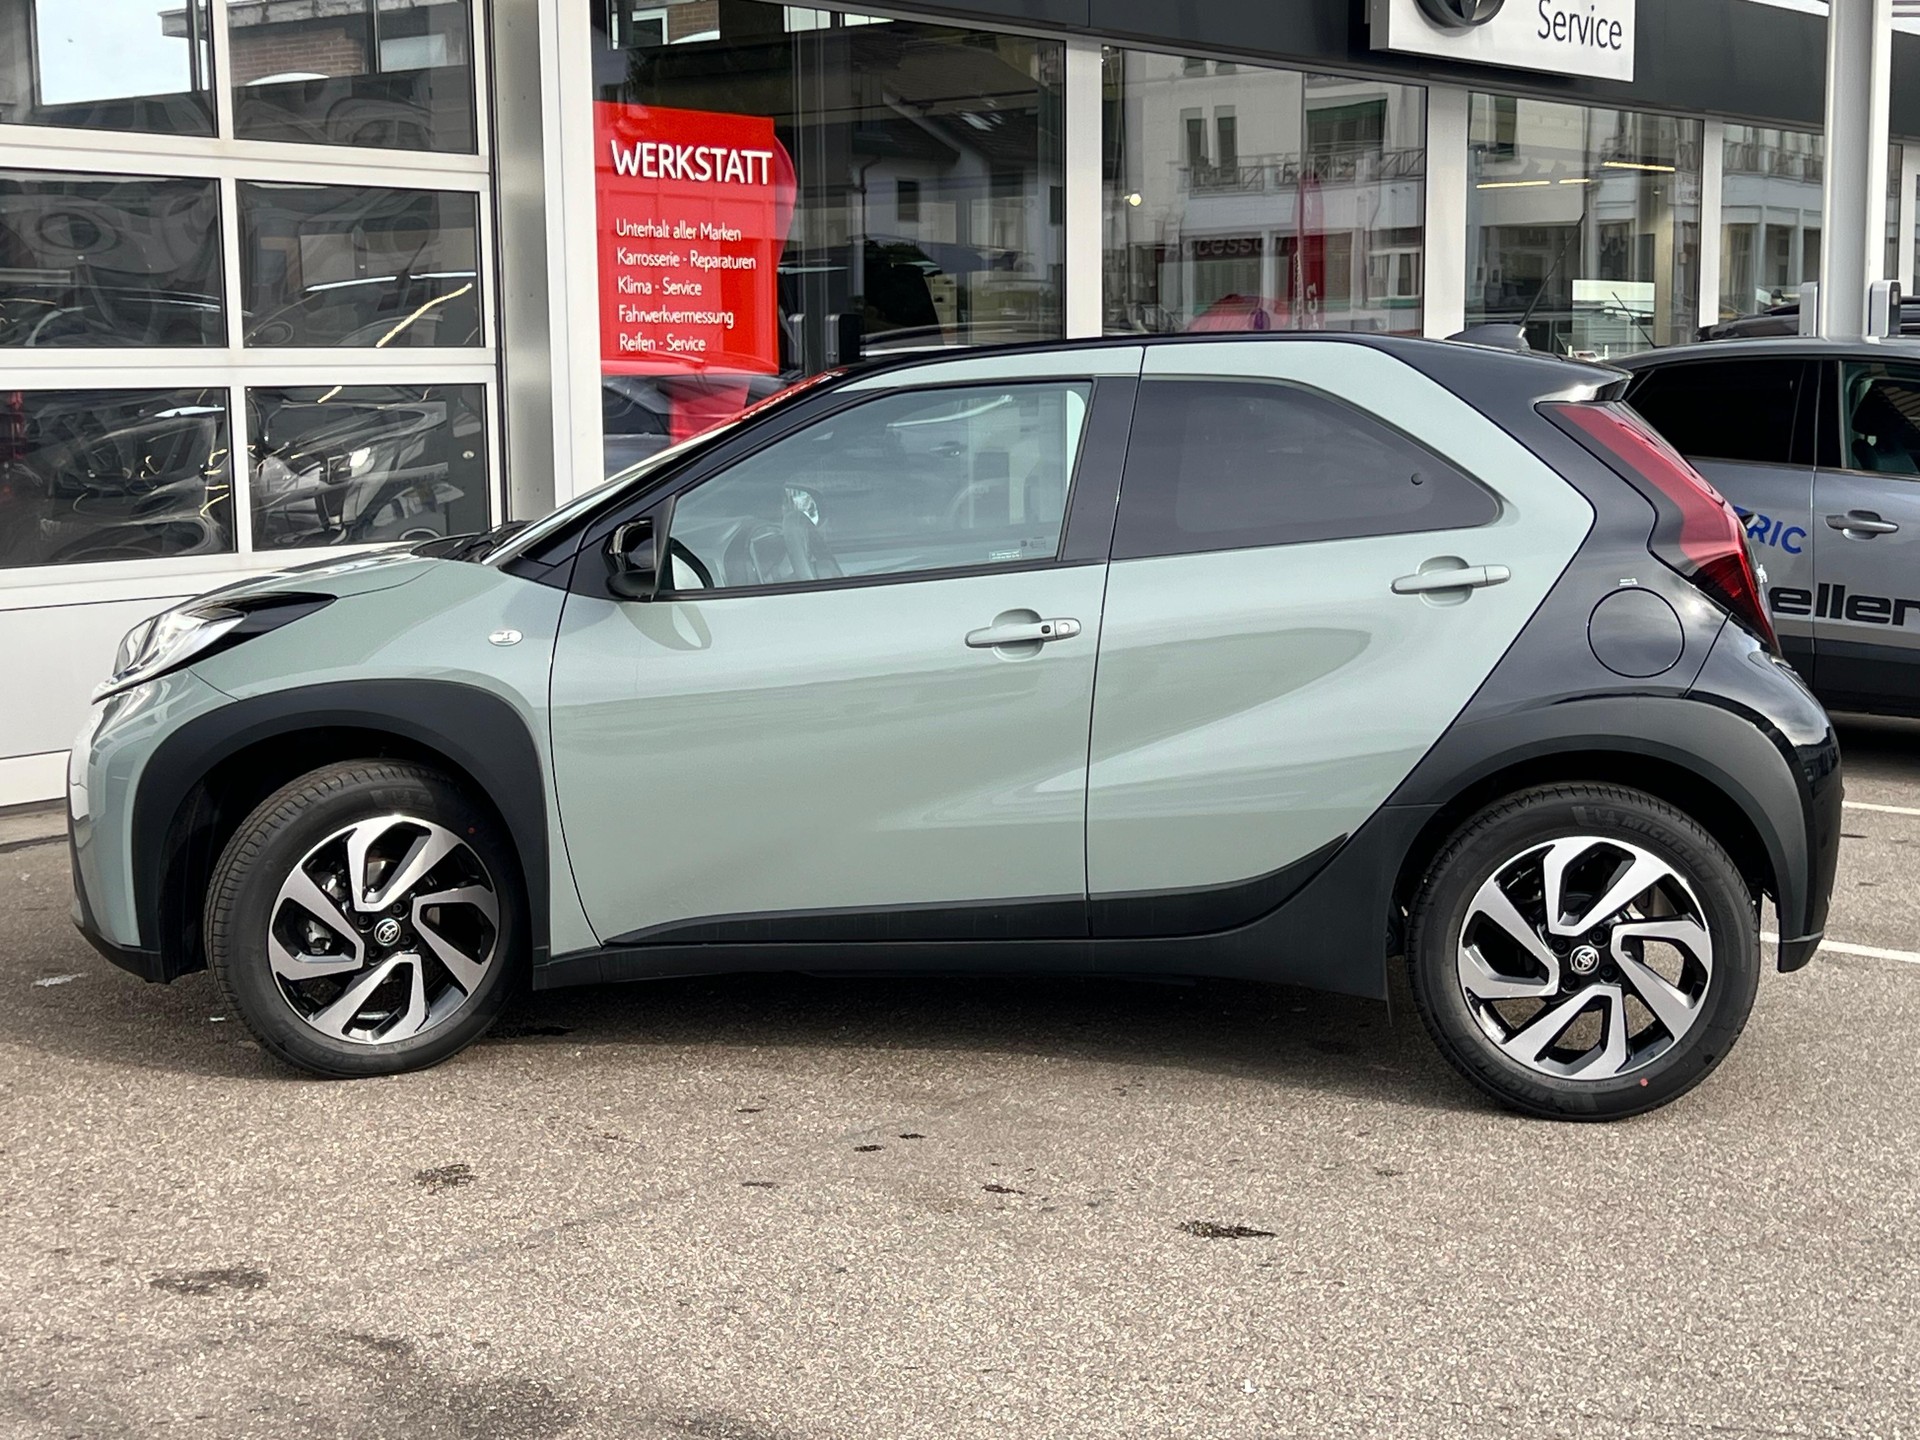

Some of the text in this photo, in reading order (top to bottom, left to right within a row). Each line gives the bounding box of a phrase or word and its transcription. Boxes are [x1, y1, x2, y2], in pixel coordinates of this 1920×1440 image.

[1538, 0, 1622, 50] Service
[611, 140, 773, 185] WERKSTATT
[616, 218, 742, 242] Unterhalt aller Marken
[617, 247, 680, 268] Karrosserie
[689, 250, 757, 273] Reparaturen
[617, 276, 653, 295] Klima
[662, 277, 703, 296] Service
[618, 304, 735, 329] Fahrwerkvermessung
[619, 332, 656, 352] Reifen
[666, 333, 707, 352] Service
